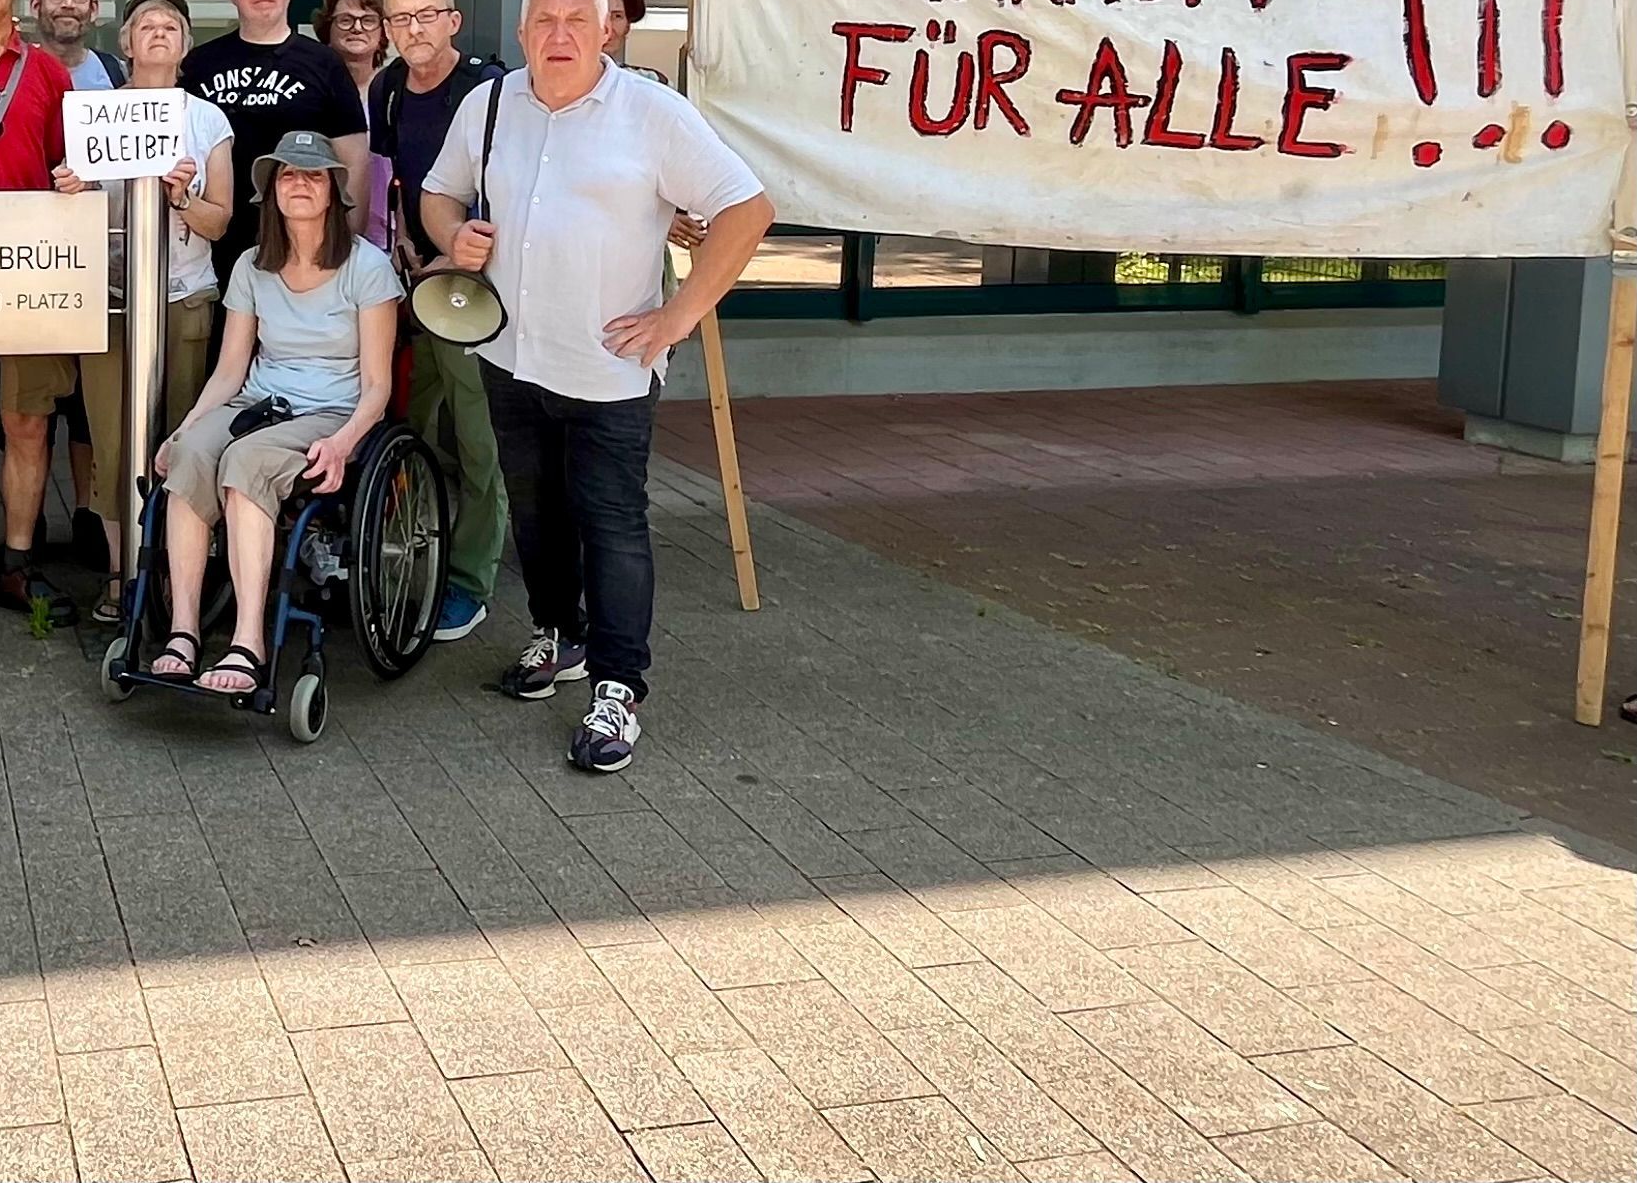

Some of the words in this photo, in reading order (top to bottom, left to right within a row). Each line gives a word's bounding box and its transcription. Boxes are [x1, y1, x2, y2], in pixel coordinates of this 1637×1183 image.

[217, 91, 279, 106] LODON
[832, 21, 1031, 138] FÜR
[1055, 38, 1356, 159] ALLE
[79, 102, 170, 125] JANETTE
[86, 134, 179, 164] BLEIBT!
[0, 240, 86, 270] BRÜHL
[17, 293, 68, 310] PLATZ
[73, 293, 83, 309] 3
